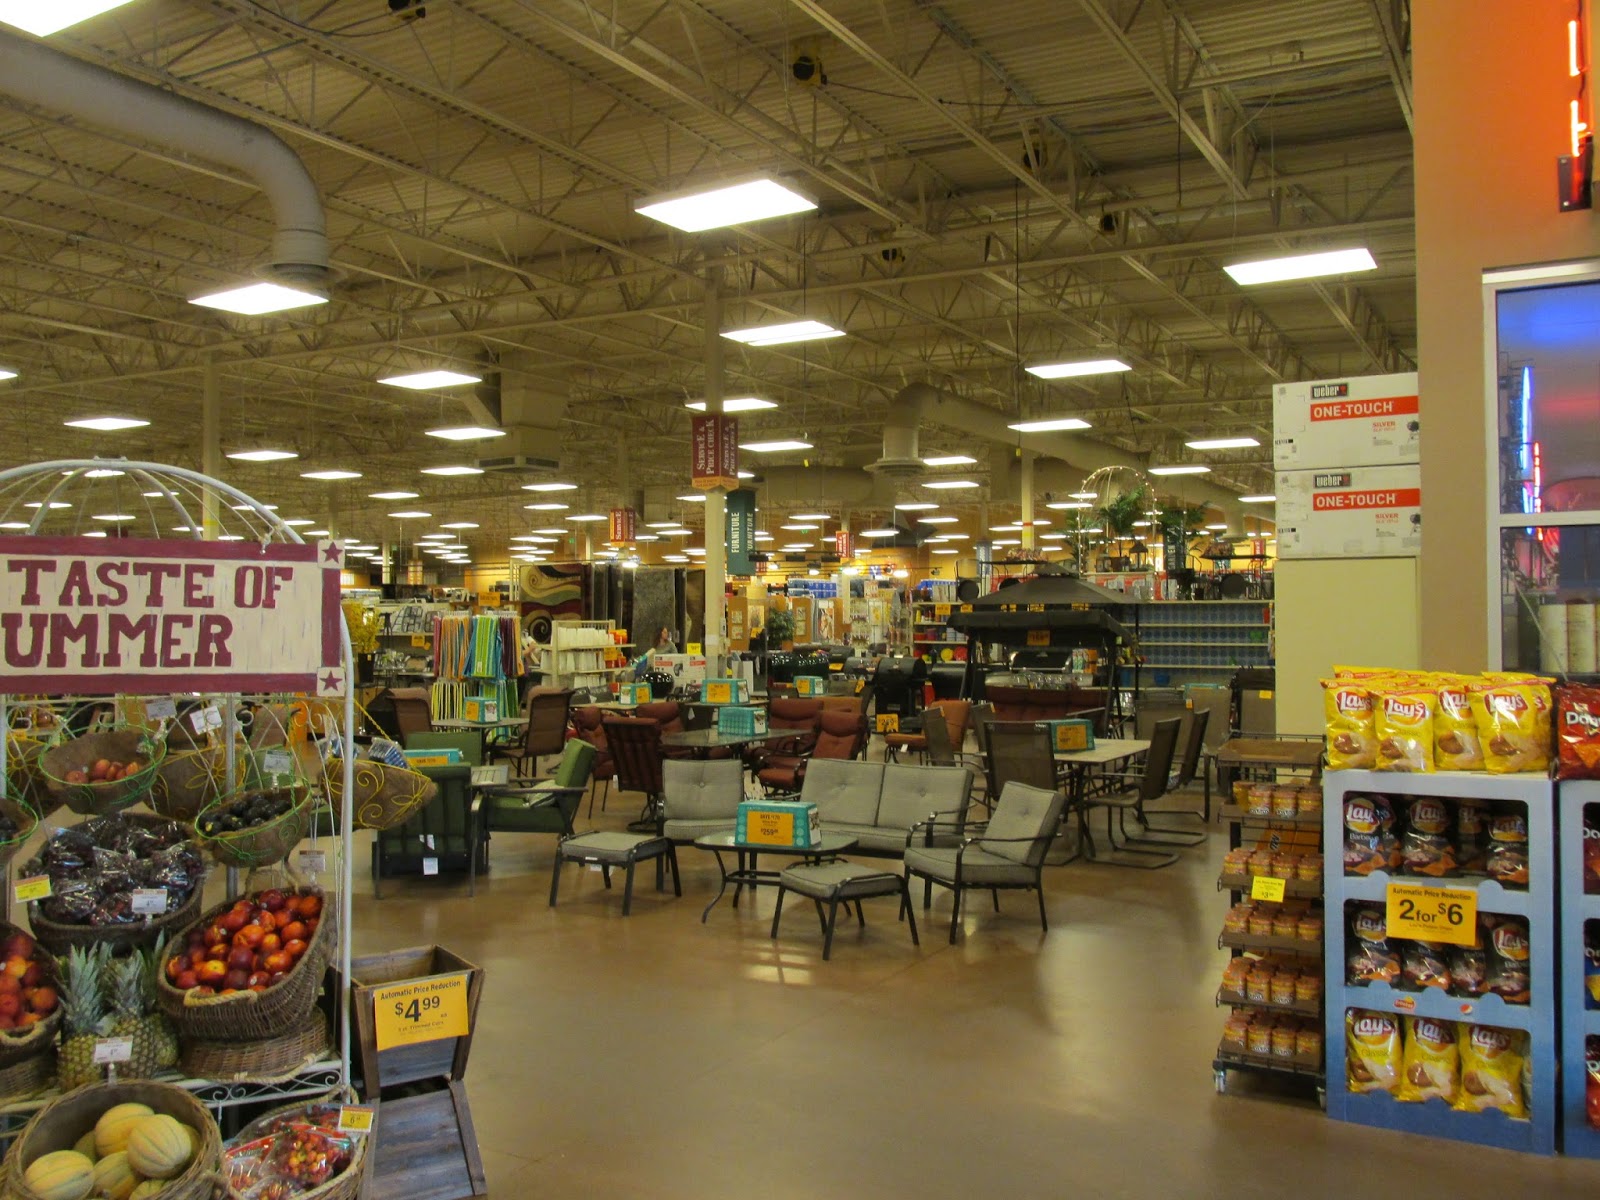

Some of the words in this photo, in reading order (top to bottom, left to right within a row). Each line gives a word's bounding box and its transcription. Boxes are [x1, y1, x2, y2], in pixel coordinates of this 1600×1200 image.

[1313, 401, 1393, 418] ONE-TOUCH
[706, 419, 715, 448] CHECK
[706, 449, 715, 475] PRICE
[1316, 493, 1396, 508] ONE-TOUCH
[731, 512, 740, 553] FURNITURE
[7, 560, 215, 607] TASTE
[234, 565, 294, 609] OF
[1393, 888, 1423, 897] Automatic
[1424, 890, 1440, 898] Price
[1442, 891, 1472, 900] Reduction
[1399, 899, 1415, 920] 2
[1416, 910, 1438, 923] for
[380, 988, 412, 1001] Automatic
[413, 985, 430, 995] Price
[430, 980, 461, 992] Reduction
